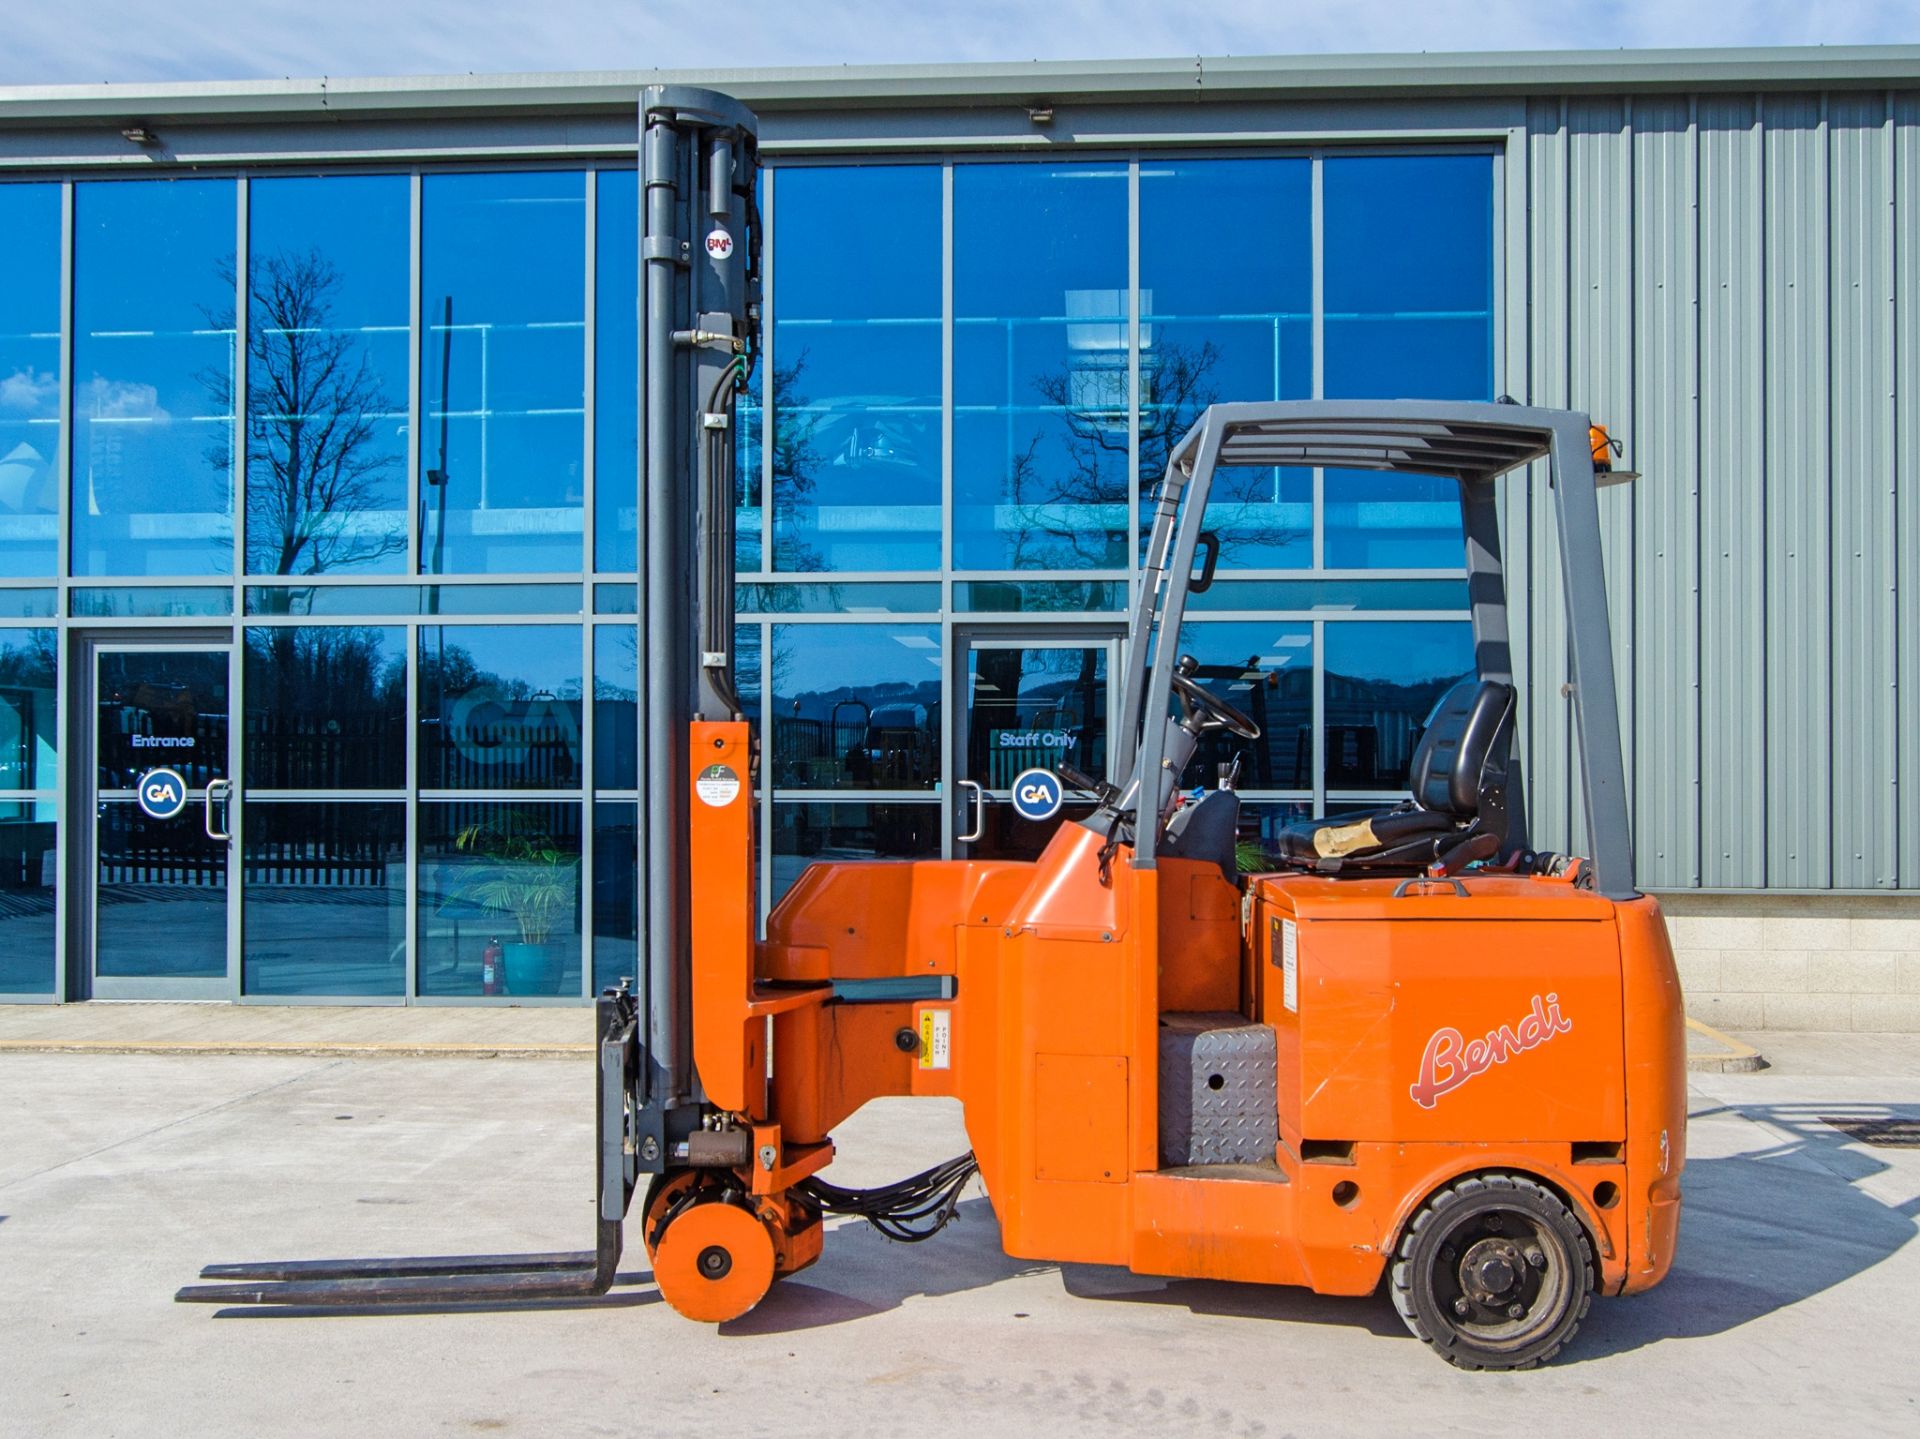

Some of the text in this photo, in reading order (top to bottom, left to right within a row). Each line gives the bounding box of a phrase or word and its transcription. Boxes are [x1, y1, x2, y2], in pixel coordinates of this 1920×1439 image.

[132, 734, 195, 747] Entrance
[1000, 732, 1077, 749] Staff Only
[146, 784, 177, 802] GA
[1020, 785, 1053, 803] GA
[1410, 993, 1572, 1109] Bendi
